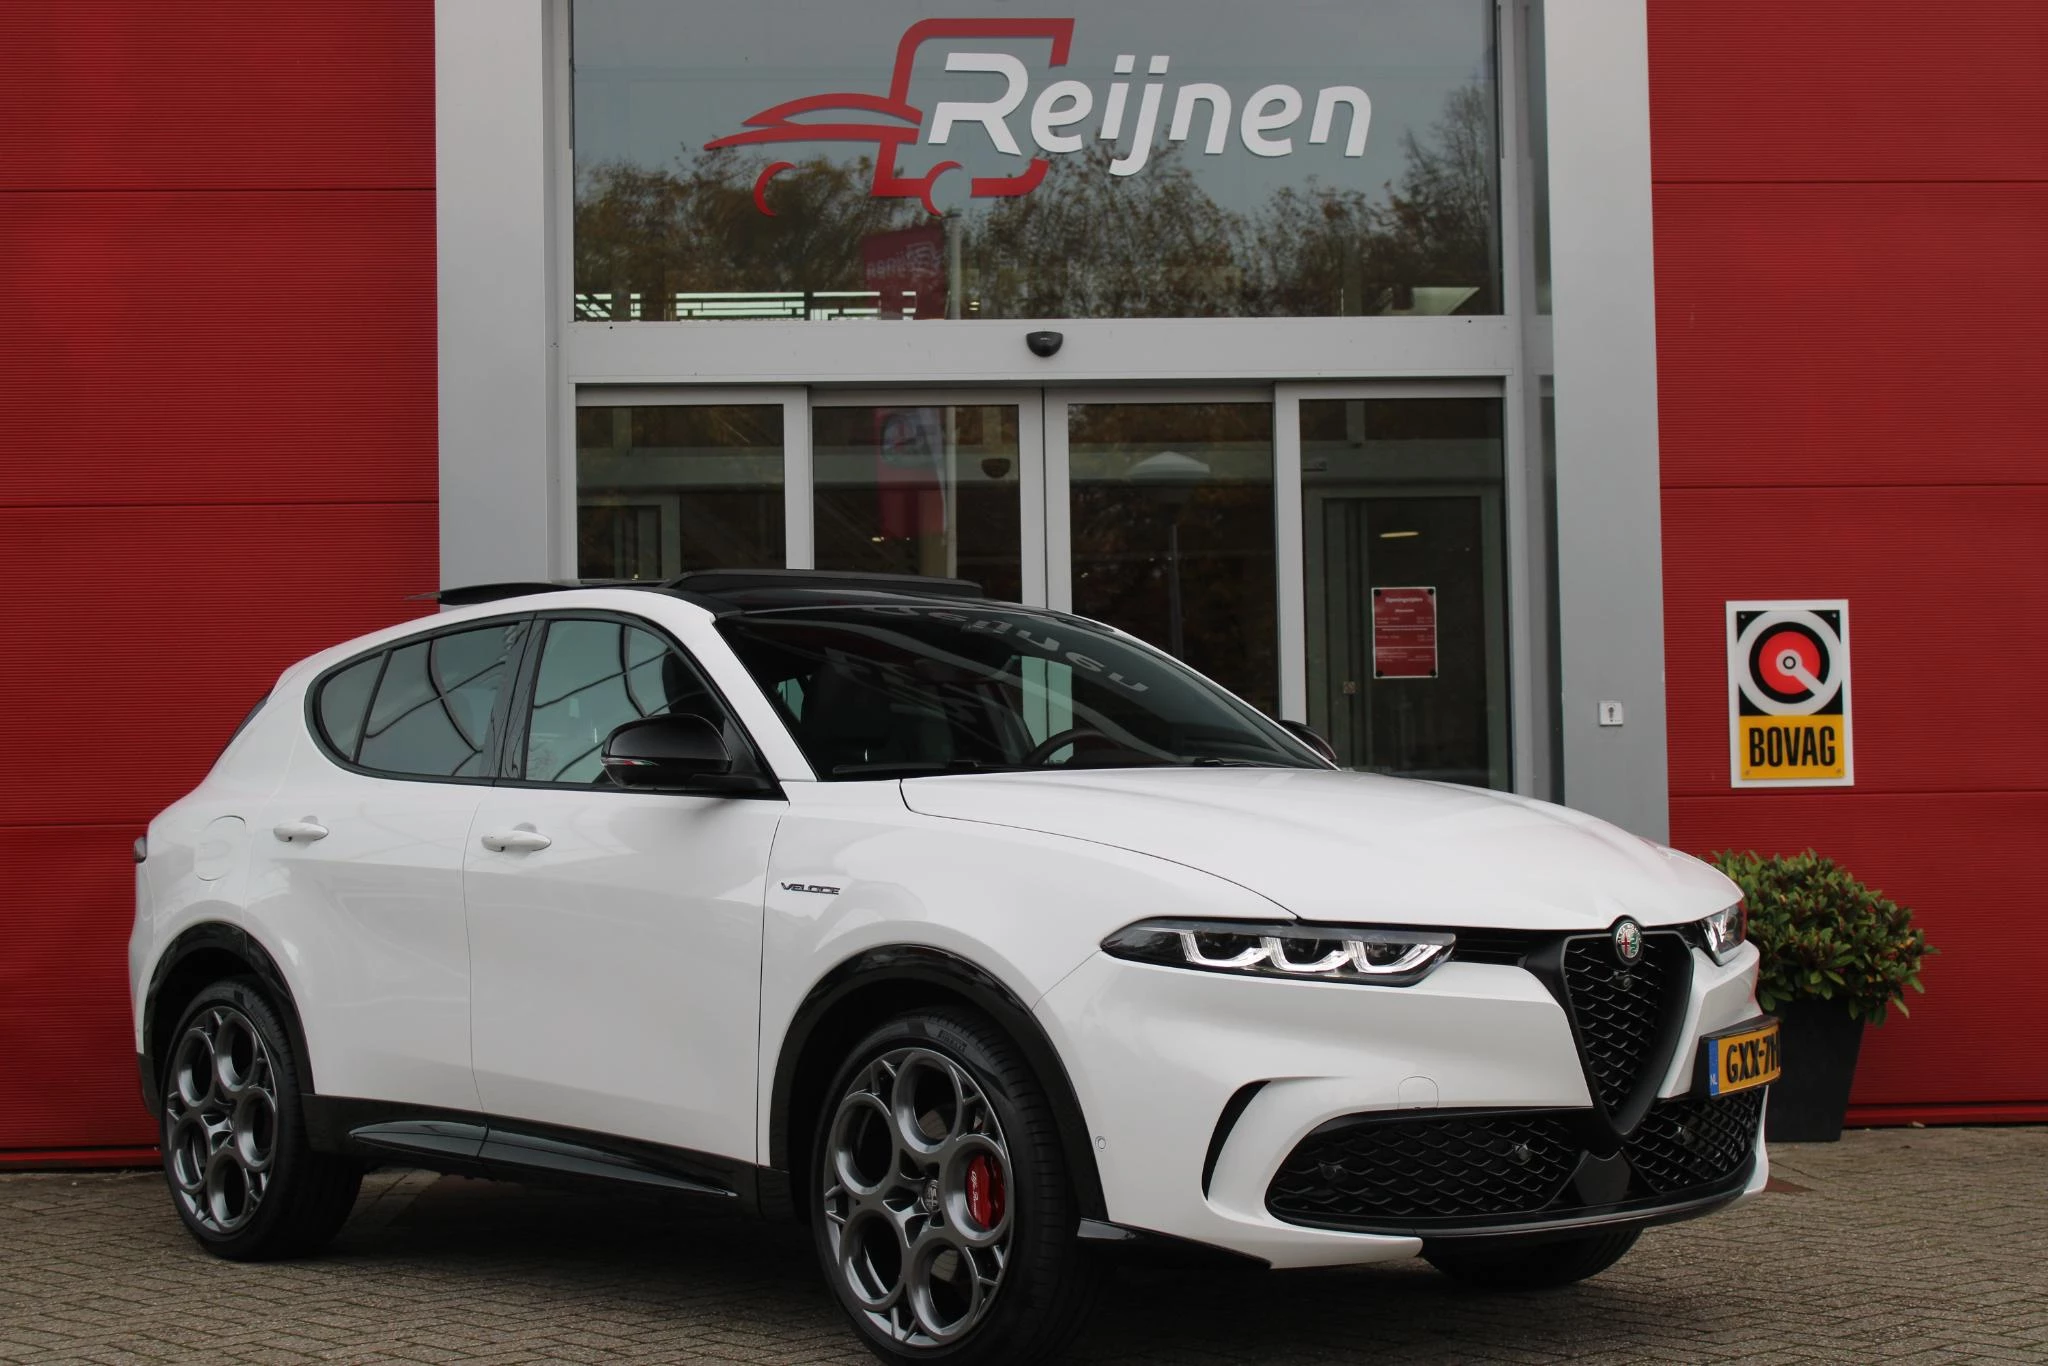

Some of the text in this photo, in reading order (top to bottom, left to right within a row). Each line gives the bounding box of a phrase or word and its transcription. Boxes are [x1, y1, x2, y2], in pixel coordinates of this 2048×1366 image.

[927, 52, 1372, 177] Reijnen
[1749, 726, 1836, 768] BOVAG
[781, 882, 841, 895] VELOCE
